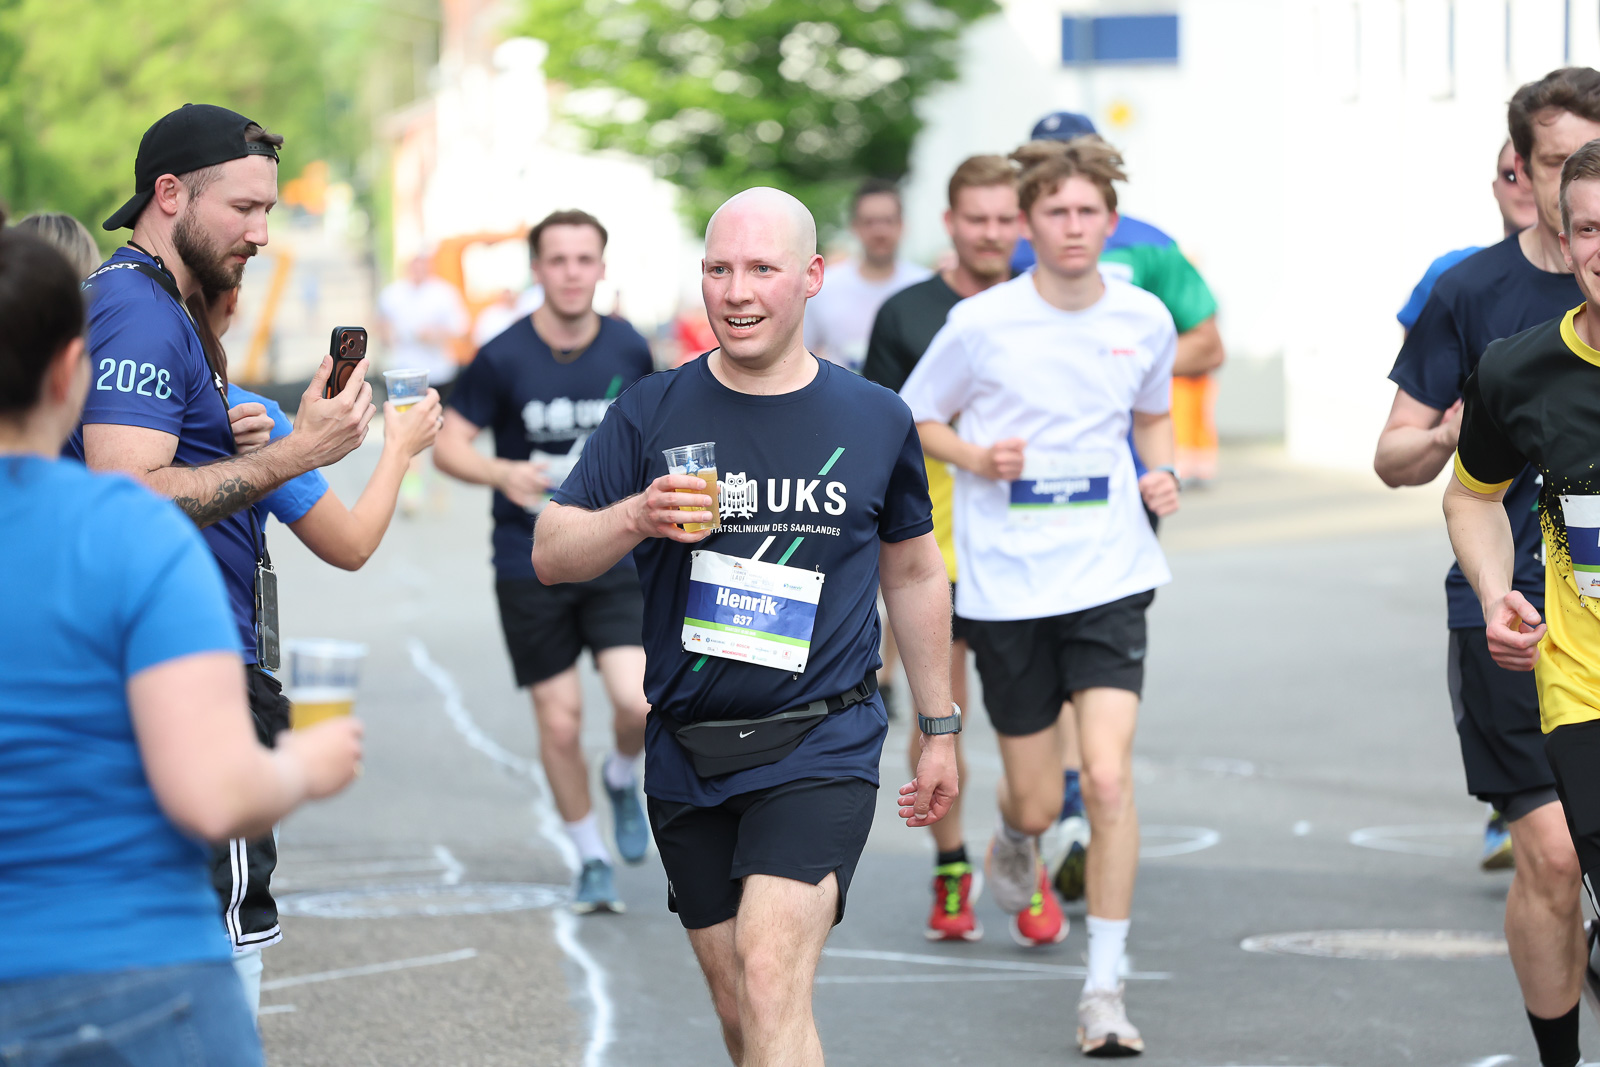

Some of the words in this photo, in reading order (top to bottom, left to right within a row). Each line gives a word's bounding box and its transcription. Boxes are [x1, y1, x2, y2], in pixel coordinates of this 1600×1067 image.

[87, 263, 140, 280] SONY
[96, 357, 172, 400] 2026
[767, 478, 847, 516] UKS
[772, 523, 788, 532] DES
[790, 523, 841, 536] SAARLANDES
[715, 586, 778, 616] Henrik
[732, 614, 753, 626] 637
